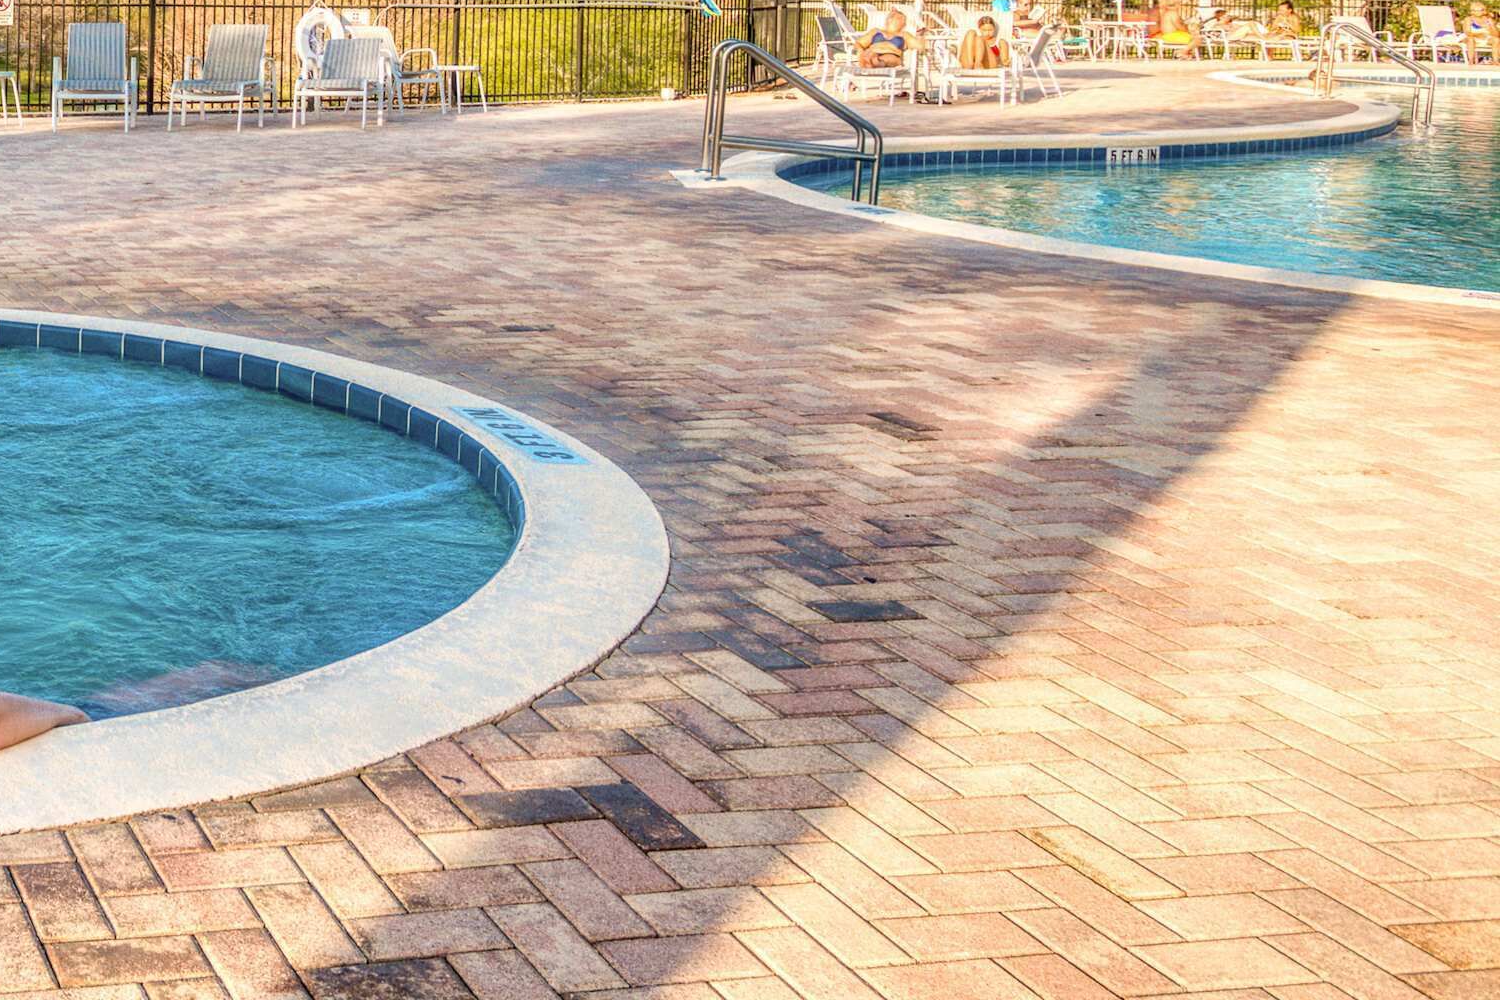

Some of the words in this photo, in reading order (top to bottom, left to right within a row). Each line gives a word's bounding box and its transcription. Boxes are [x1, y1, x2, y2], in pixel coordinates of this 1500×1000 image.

[1122, 150, 1133, 161] FT
[1138, 149, 1143, 160] 6
[1148, 149, 1157, 160] IN
[462, 408, 510, 421] IN
[486, 422, 525, 430] 6
[503, 433, 557, 447] FT
[533, 451, 575, 460] 3
